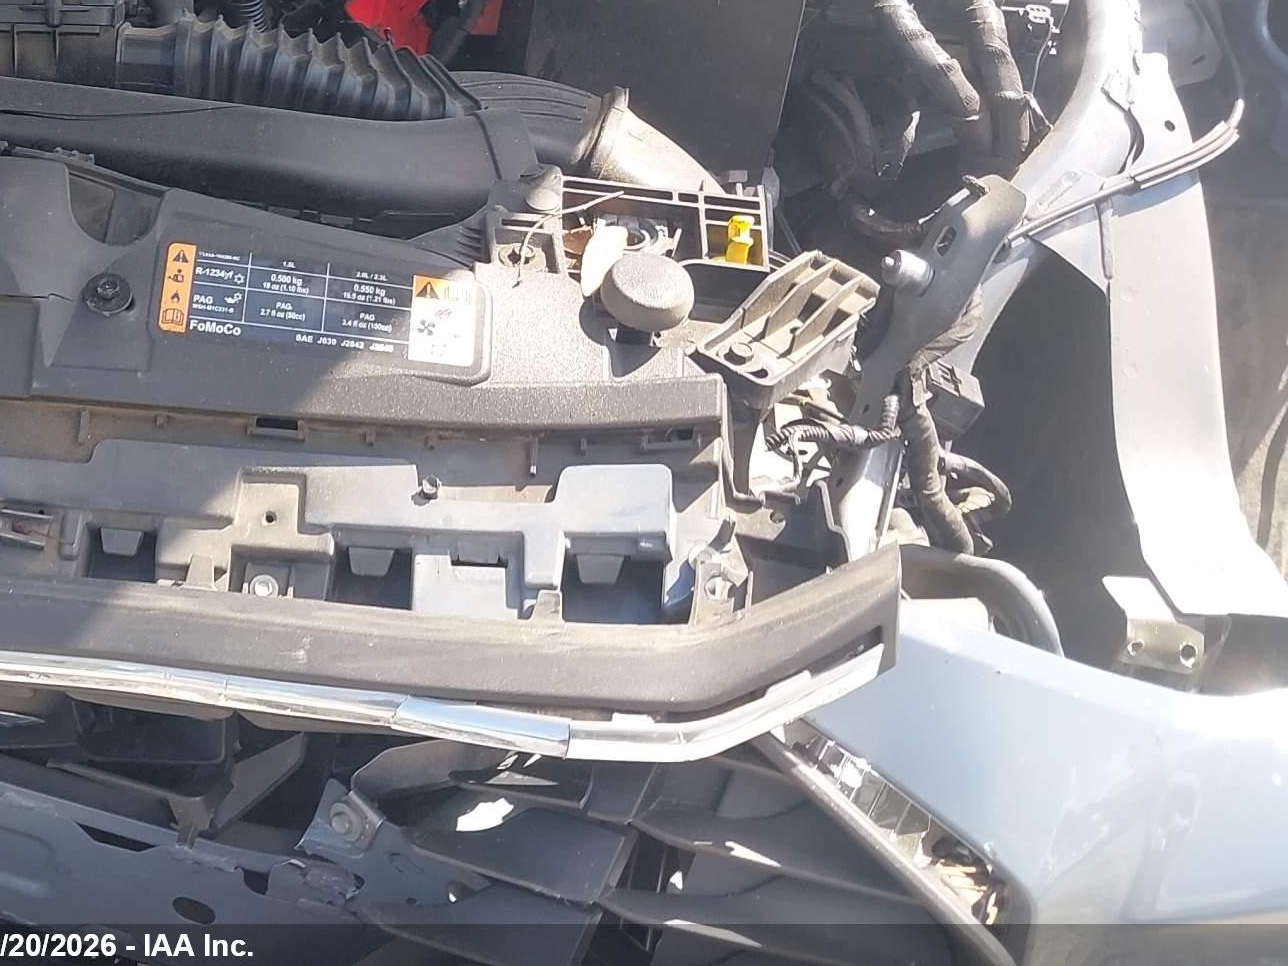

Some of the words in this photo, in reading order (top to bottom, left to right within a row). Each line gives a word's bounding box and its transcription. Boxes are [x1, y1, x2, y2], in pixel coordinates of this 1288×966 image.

[195, 266, 234, 280] R-1234yf
[270, 273, 292, 284] 0.500
[292, 276, 303, 287] kg
[353, 283, 375, 294] 0.550
[375, 286, 386, 297] kg
[193, 294, 213, 304] PAG
[275, 301, 292, 310] PAG
[359, 313, 376, 321] PAG
[189, 319, 242, 336] FoMoCo
[295, 333, 313, 343] SAE
